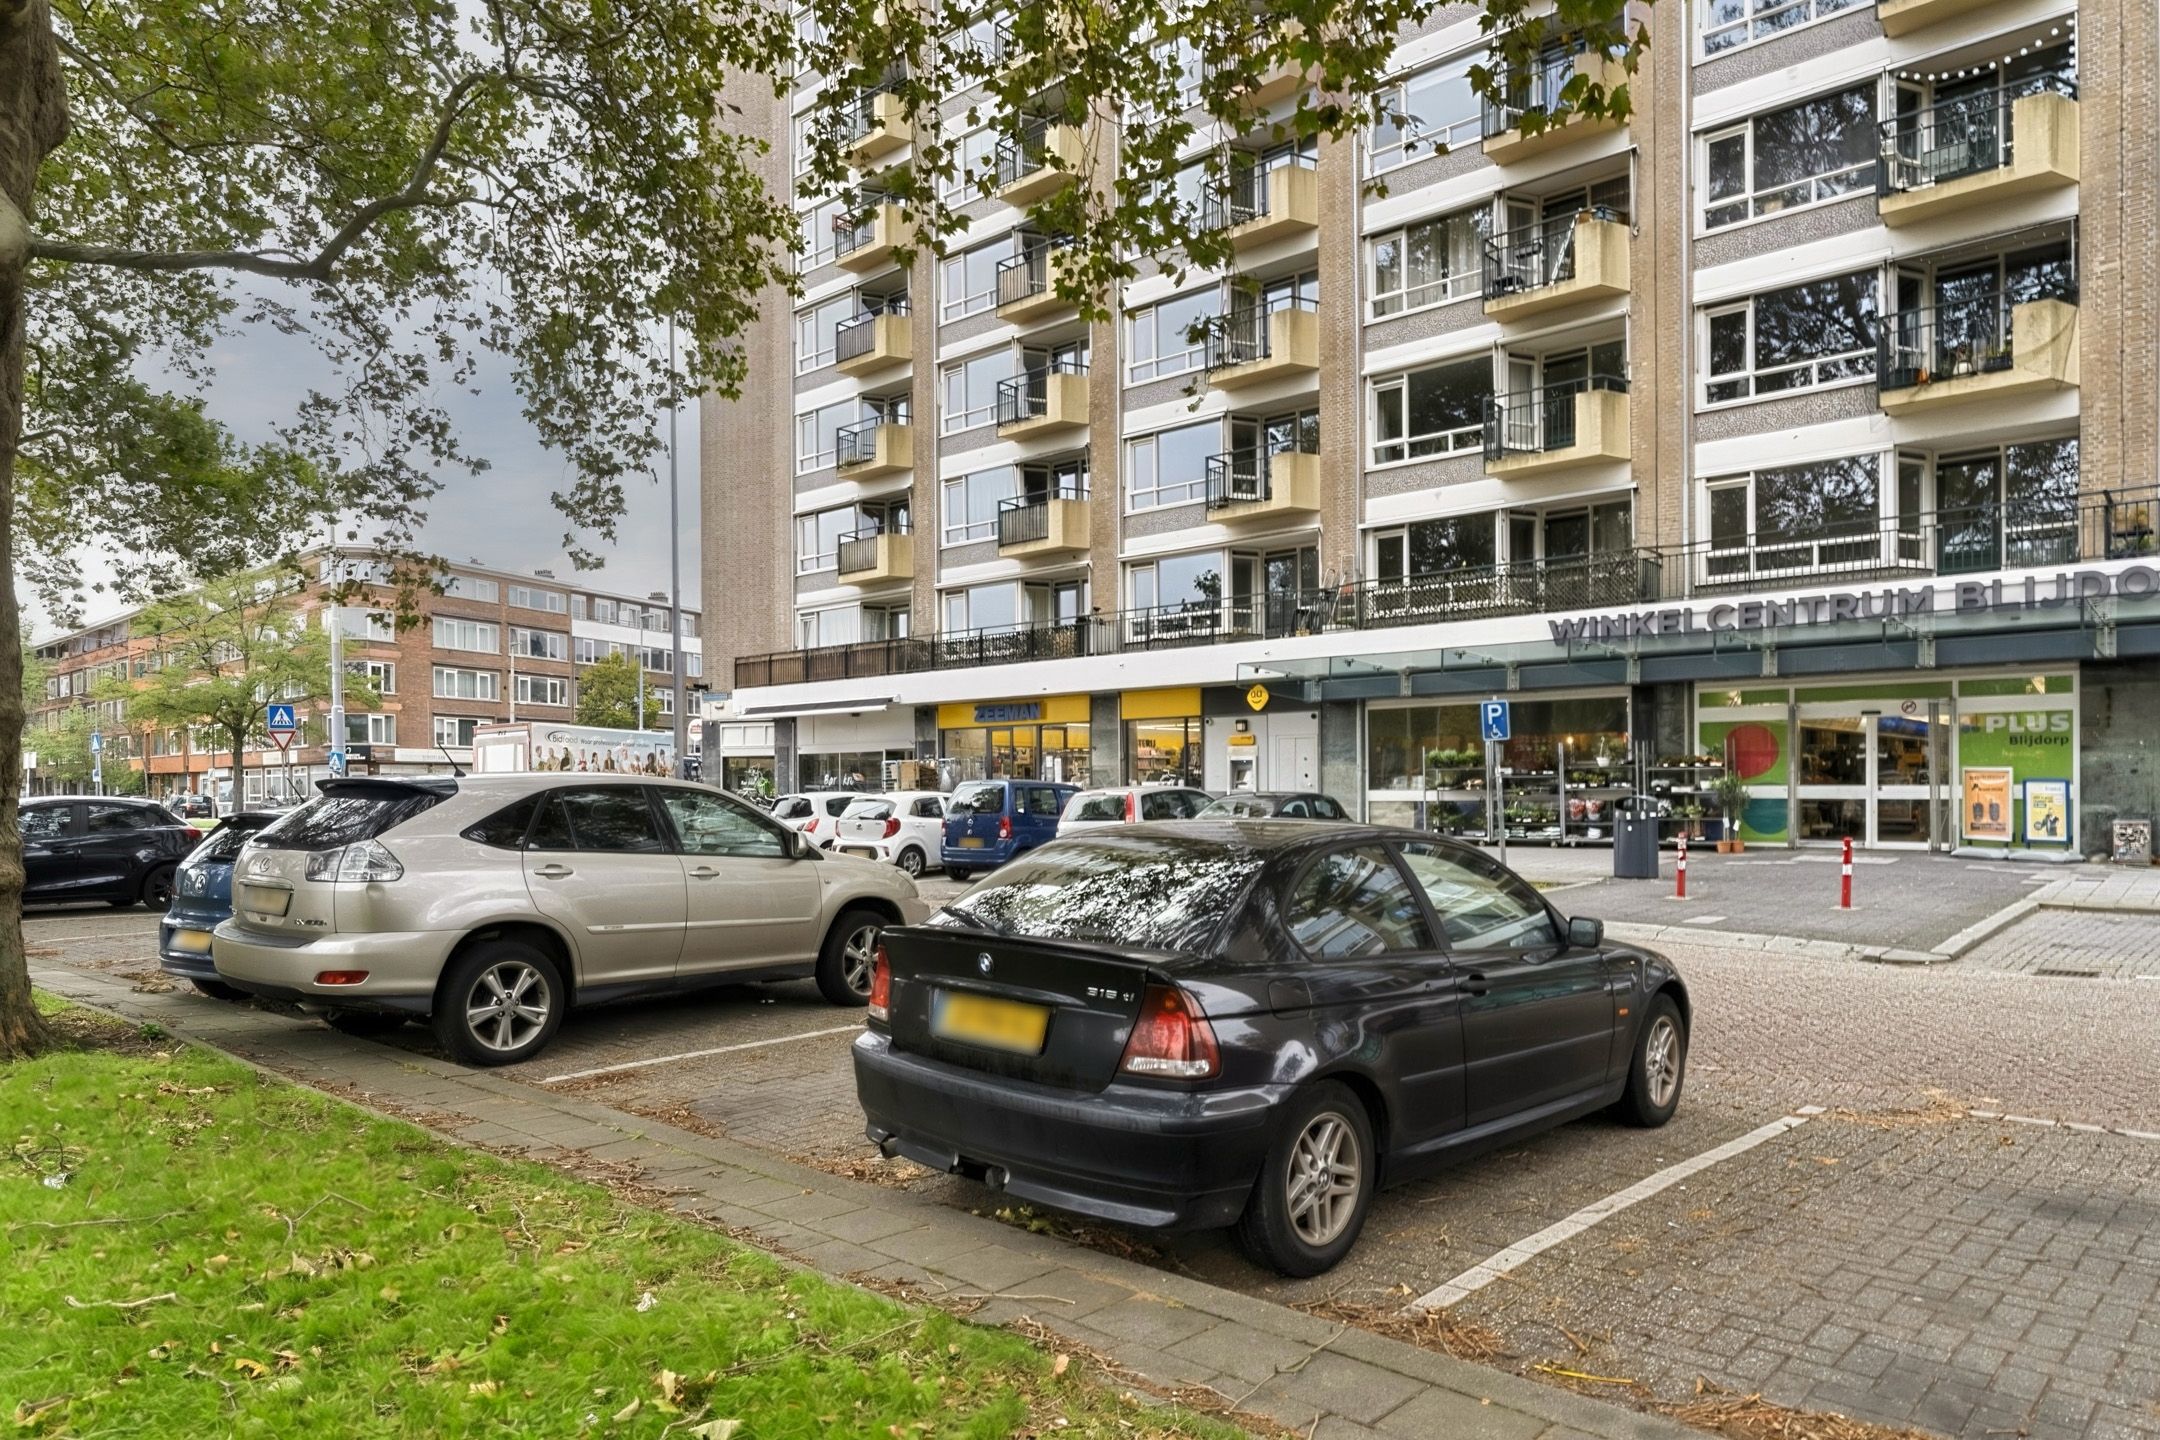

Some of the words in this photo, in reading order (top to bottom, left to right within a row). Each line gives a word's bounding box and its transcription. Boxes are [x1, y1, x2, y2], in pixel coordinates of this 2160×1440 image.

[1547, 584, 1934, 647] WINKELCENTRUM
[974, 702, 1041, 723] ZEEMAN
[1487, 704, 1502, 725] P
[1985, 710, 2070, 733] PLUS
[2009, 734, 2069, 747] Blijdorp
